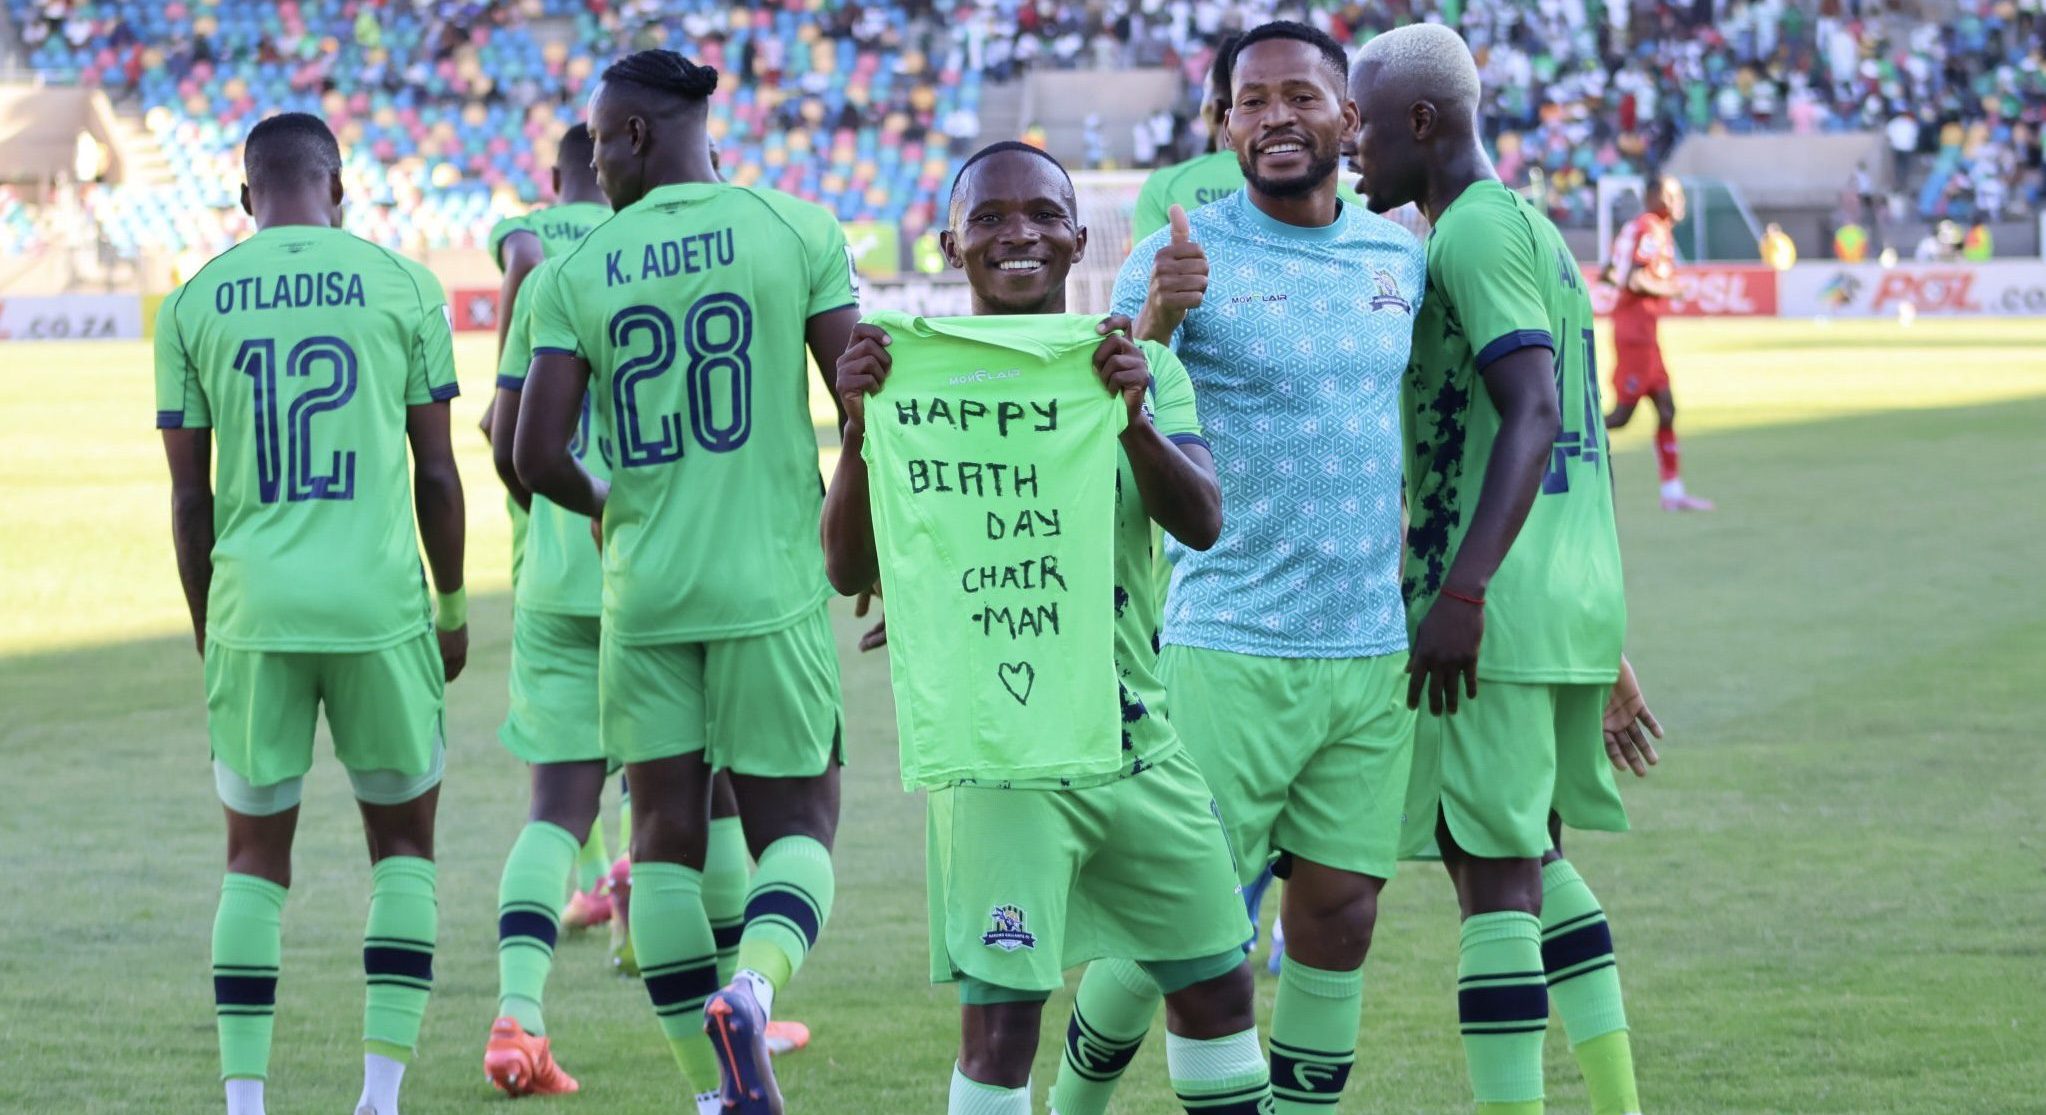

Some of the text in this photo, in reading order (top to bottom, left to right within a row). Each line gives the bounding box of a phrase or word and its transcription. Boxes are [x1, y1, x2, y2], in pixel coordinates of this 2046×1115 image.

[605, 227, 735, 288] K. ADETU
[215, 271, 366, 315] OTLADISA
[608, 291, 753, 468] 28
[232, 335, 358, 505] 12
[895, 397, 1058, 437] HAPPY
[908, 459, 1038, 498] BIRTH
[986, 508, 1062, 541] DAY
[962, 554, 1068, 593] CHAIR
